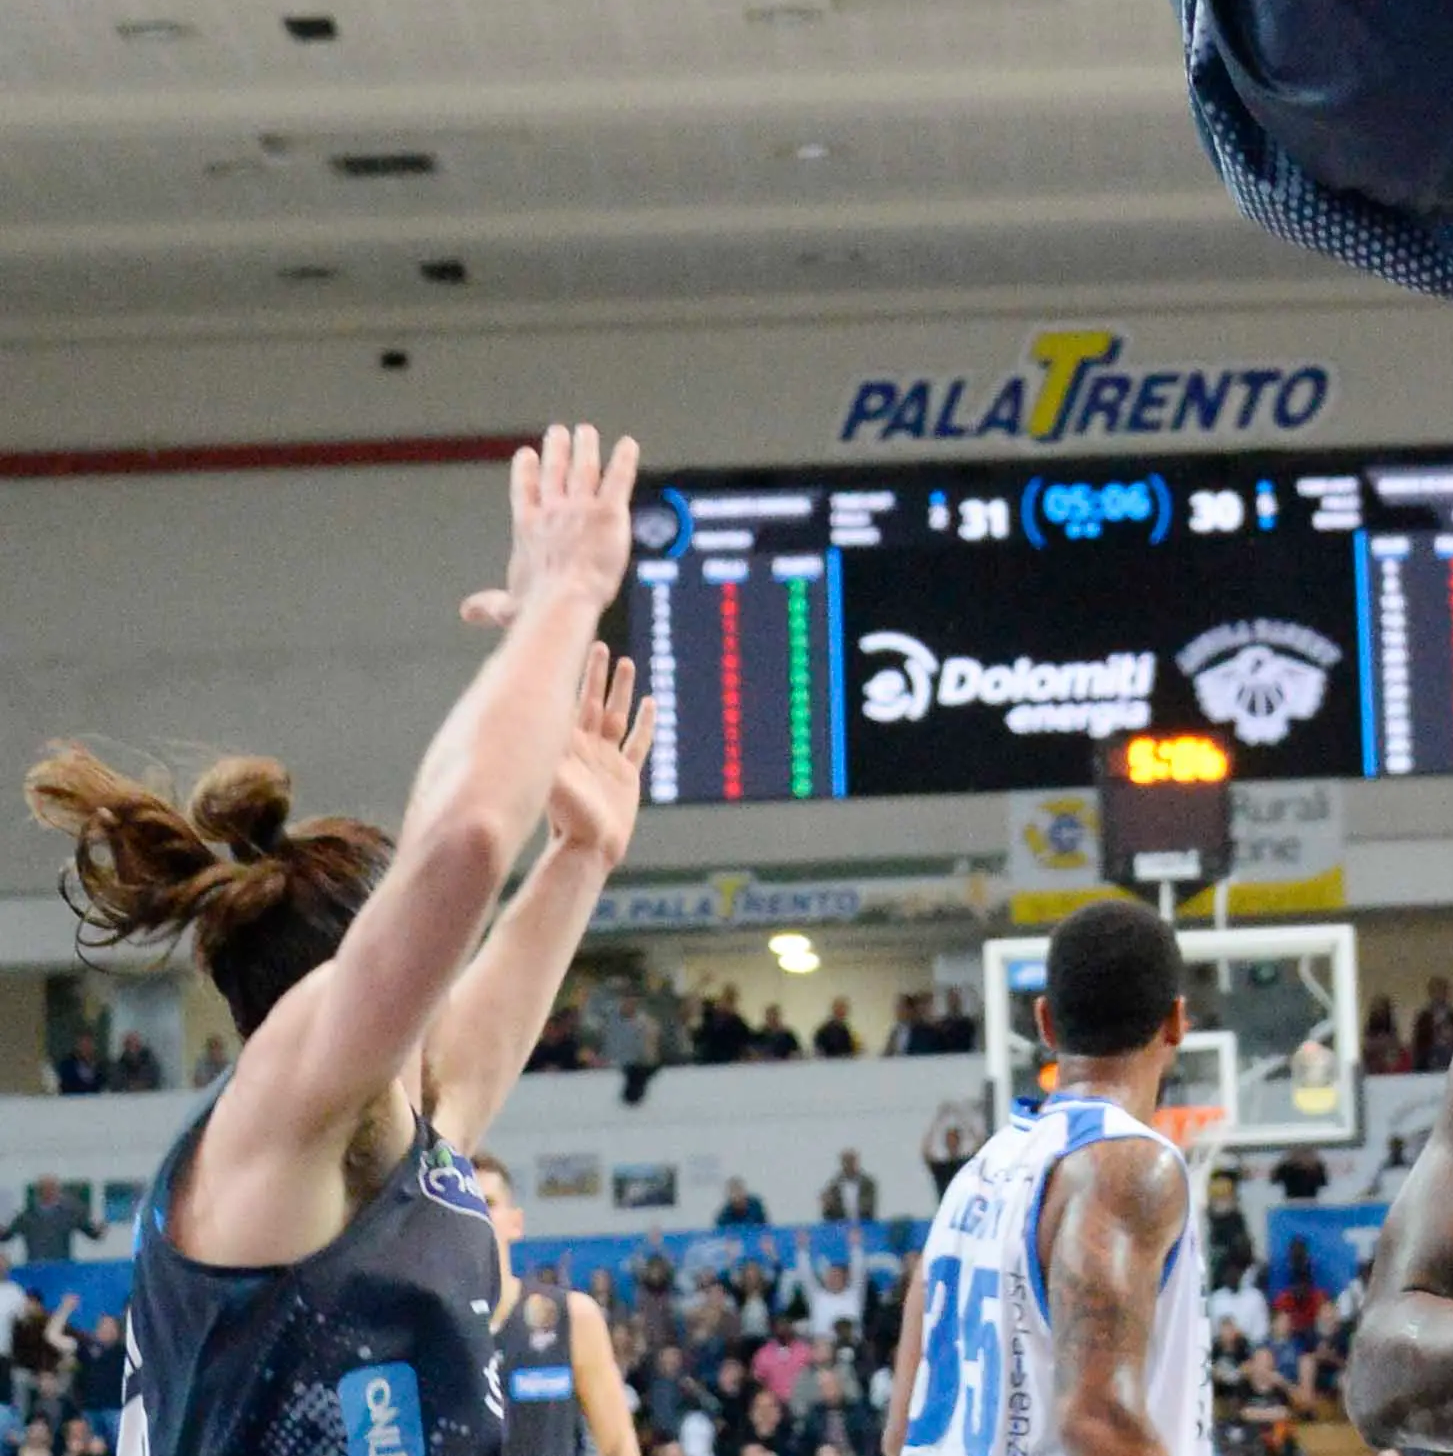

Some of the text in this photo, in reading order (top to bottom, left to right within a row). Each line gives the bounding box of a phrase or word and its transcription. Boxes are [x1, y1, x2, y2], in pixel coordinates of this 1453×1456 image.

[839, 331, 1329, 443] PALATRENTO
[957, 498, 1010, 541] 31
[1188, 489, 1245, 533] 30
[937, 651, 1157, 706] Dolomiti
[1004, 697, 1152, 739] energia
